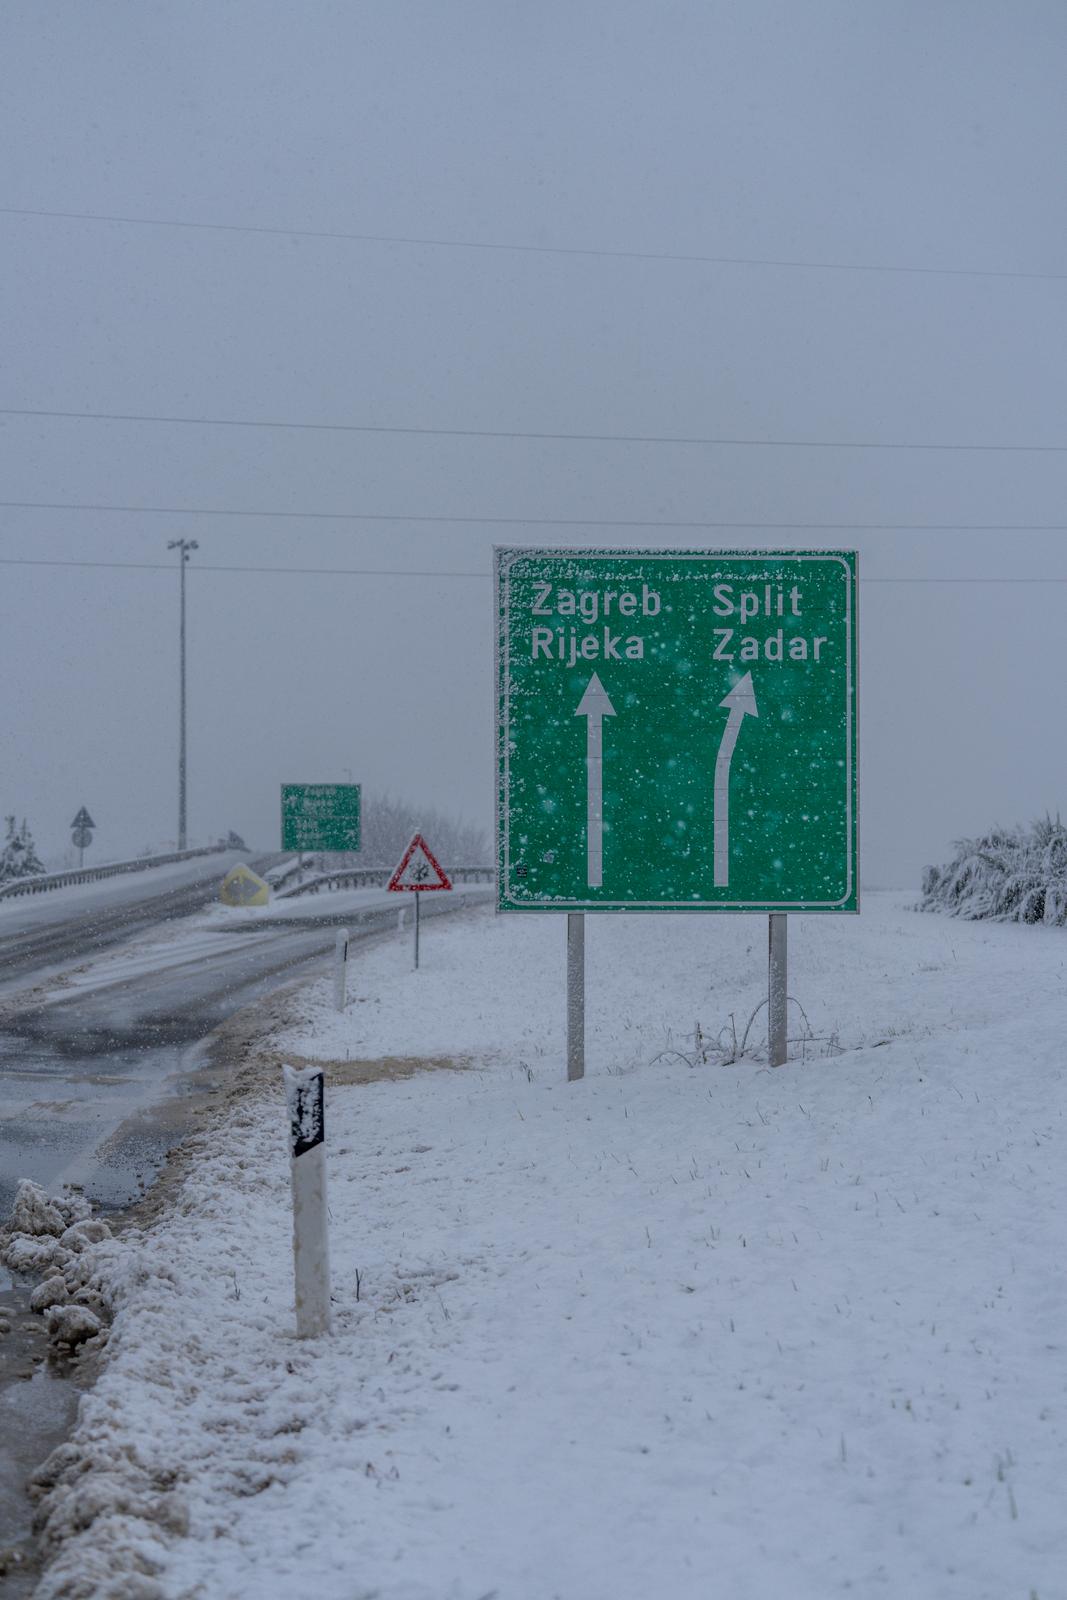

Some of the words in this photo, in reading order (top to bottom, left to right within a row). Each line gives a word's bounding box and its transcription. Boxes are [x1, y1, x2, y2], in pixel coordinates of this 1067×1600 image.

[531, 584, 661, 624] Zagreb
[713, 584, 803, 624] Split
[531, 627, 644, 667] Rijeka
[712, 629, 827, 660] Zadar
